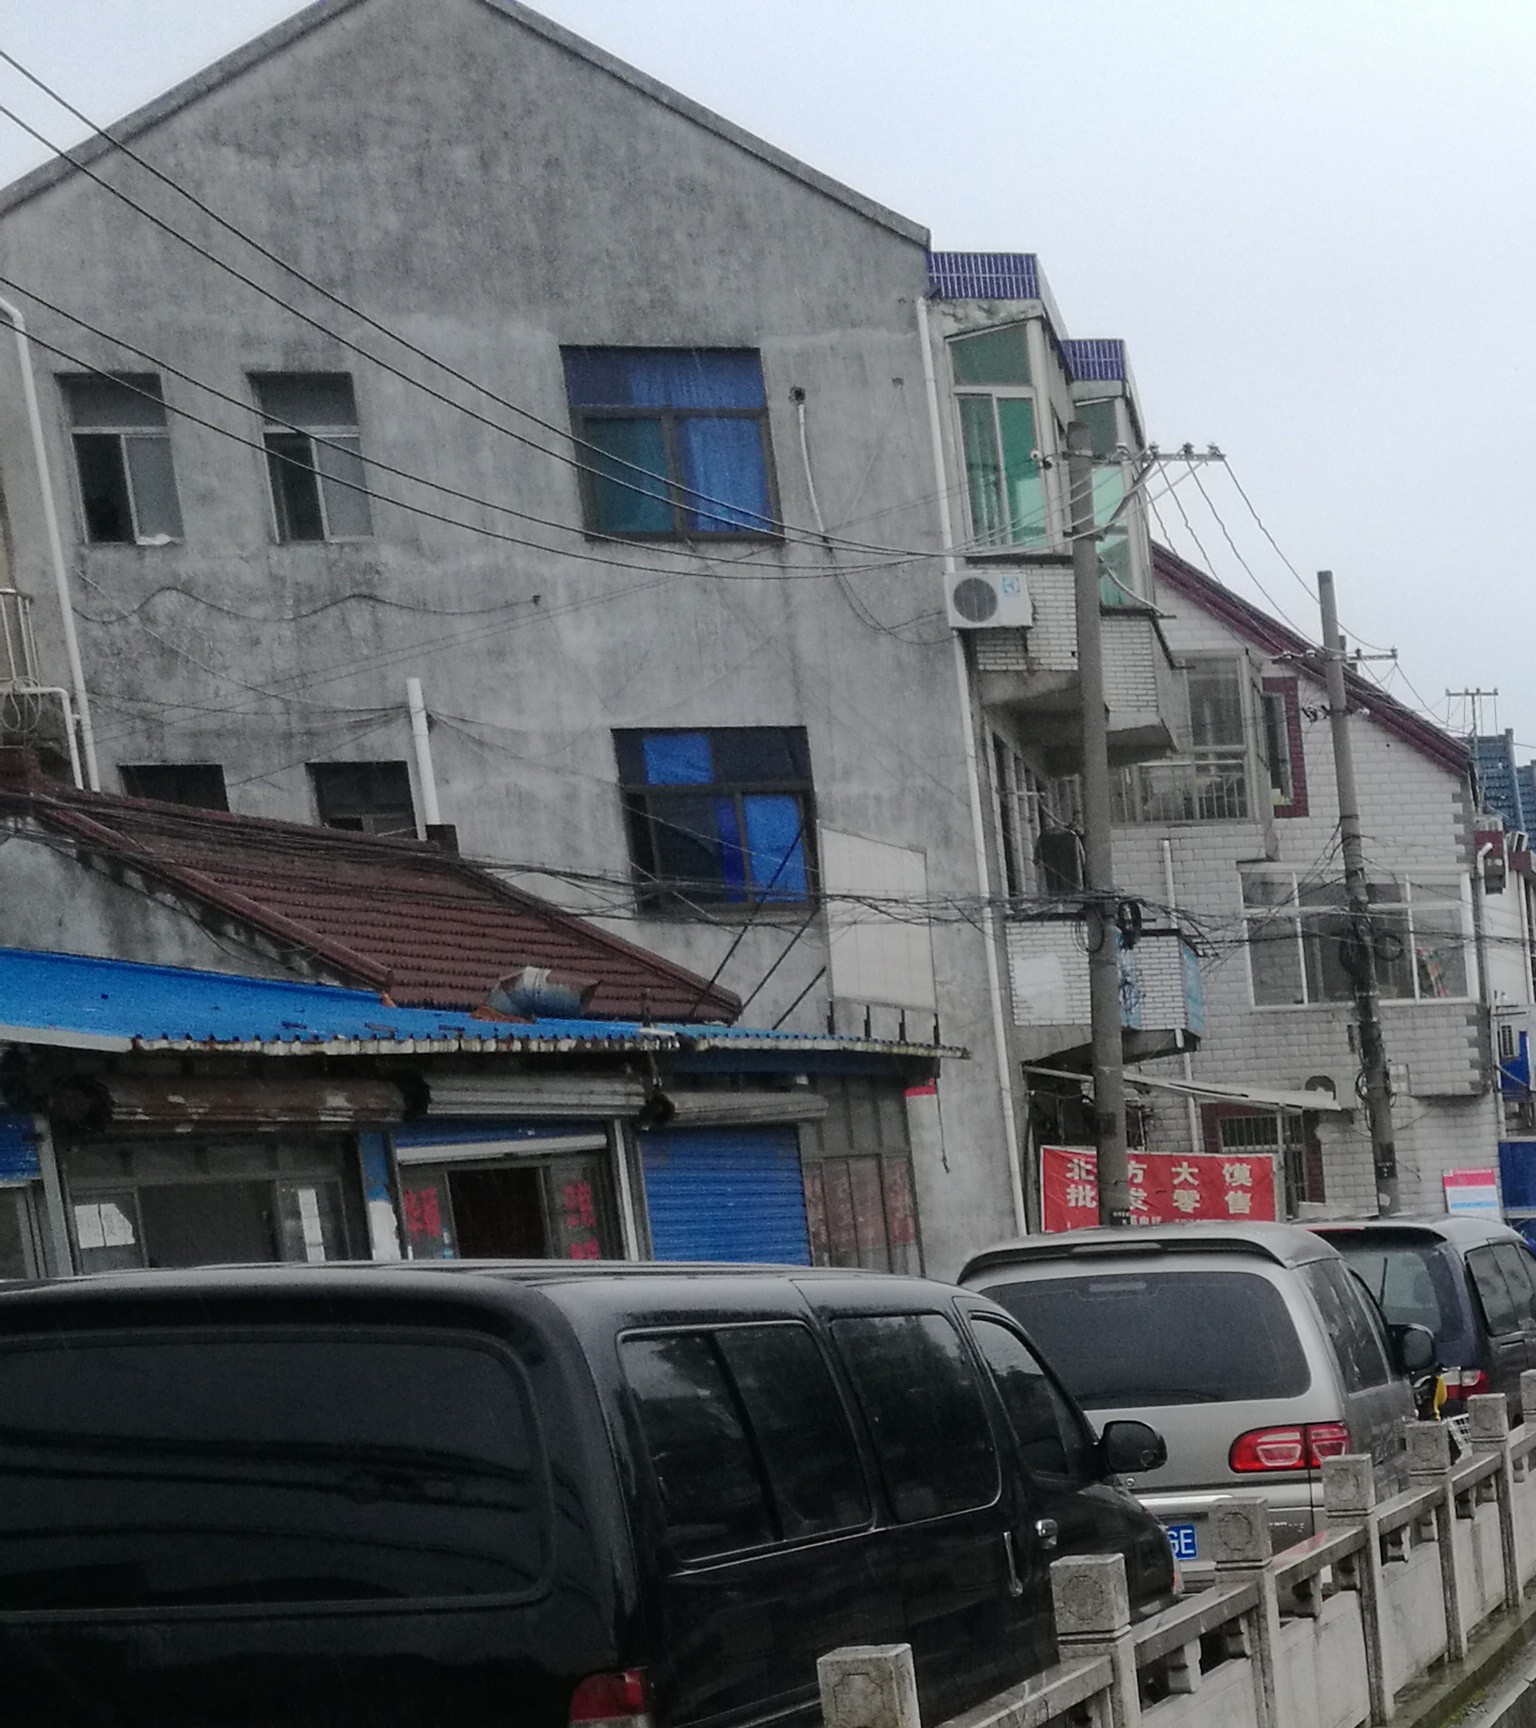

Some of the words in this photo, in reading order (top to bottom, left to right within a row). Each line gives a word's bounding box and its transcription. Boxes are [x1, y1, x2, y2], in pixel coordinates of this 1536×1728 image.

[1065, 1158, 1253, 1188] 北方大馍
[1065, 1184, 1253, 1215] 批发零售
